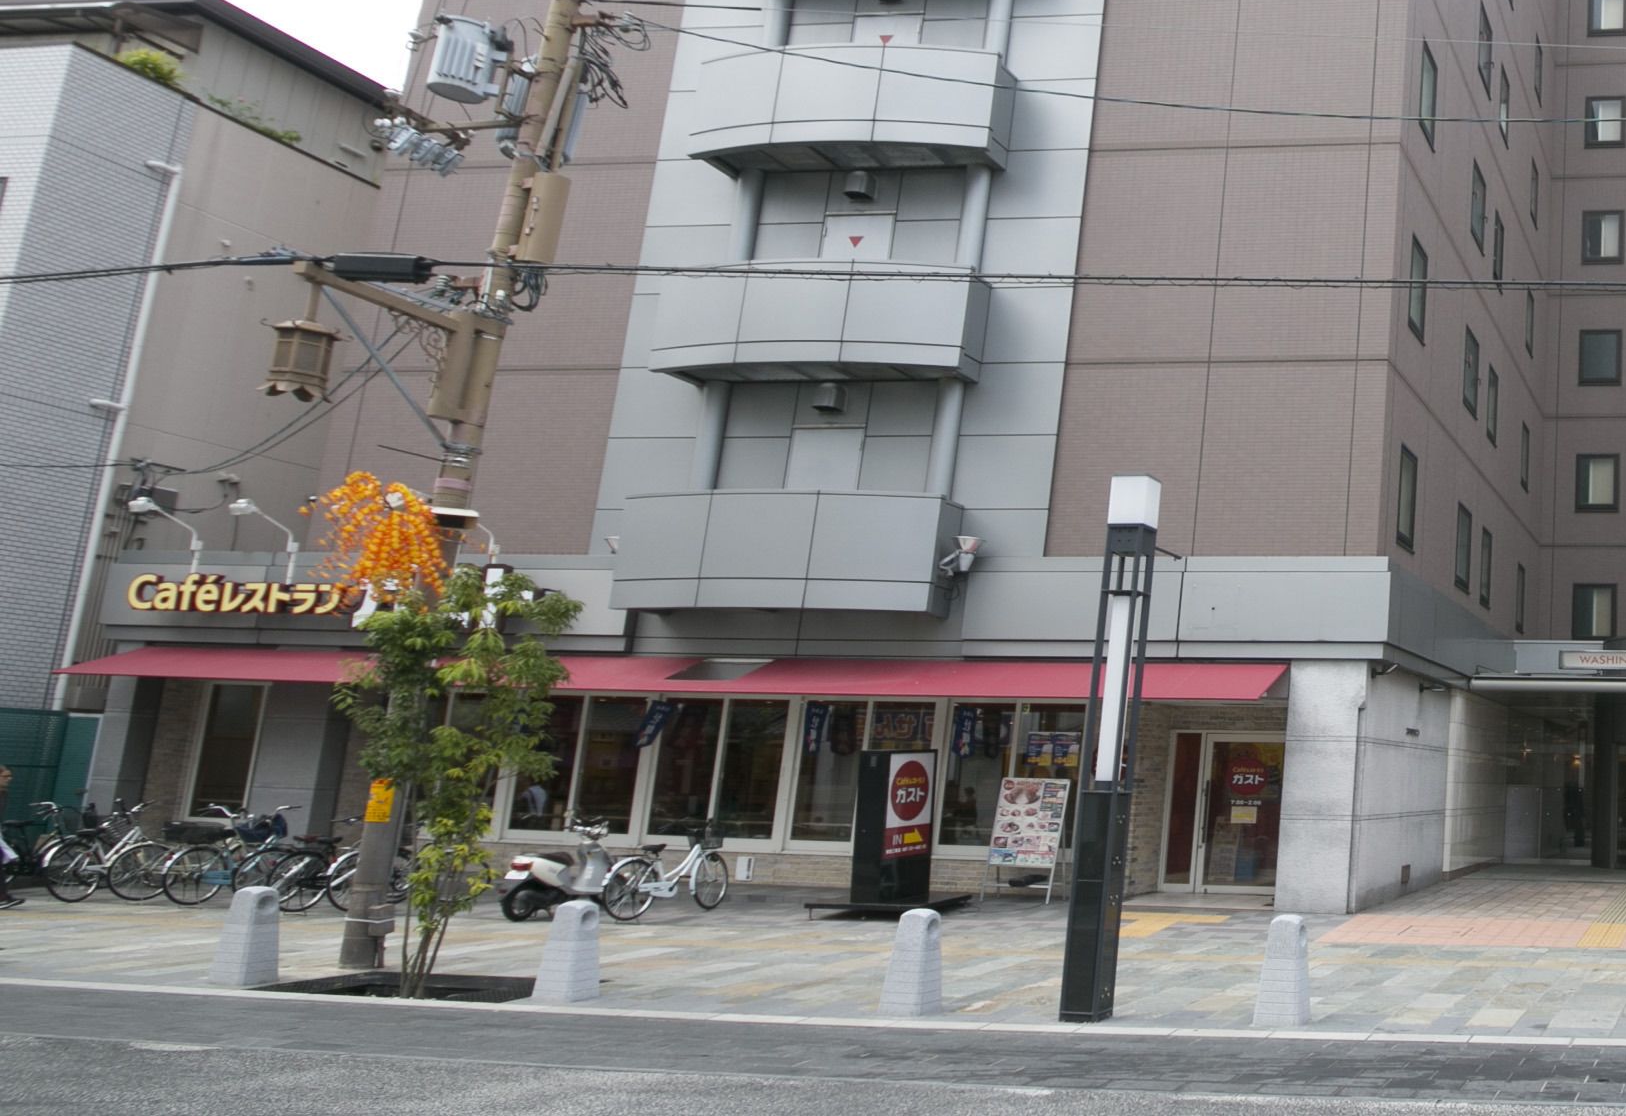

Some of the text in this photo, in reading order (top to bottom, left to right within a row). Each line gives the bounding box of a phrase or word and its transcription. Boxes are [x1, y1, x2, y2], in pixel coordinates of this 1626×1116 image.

[1232, 774, 1264, 785] ガスト
[895, 787, 925, 804] ガスト
[892, 834, 903, 846] IN
